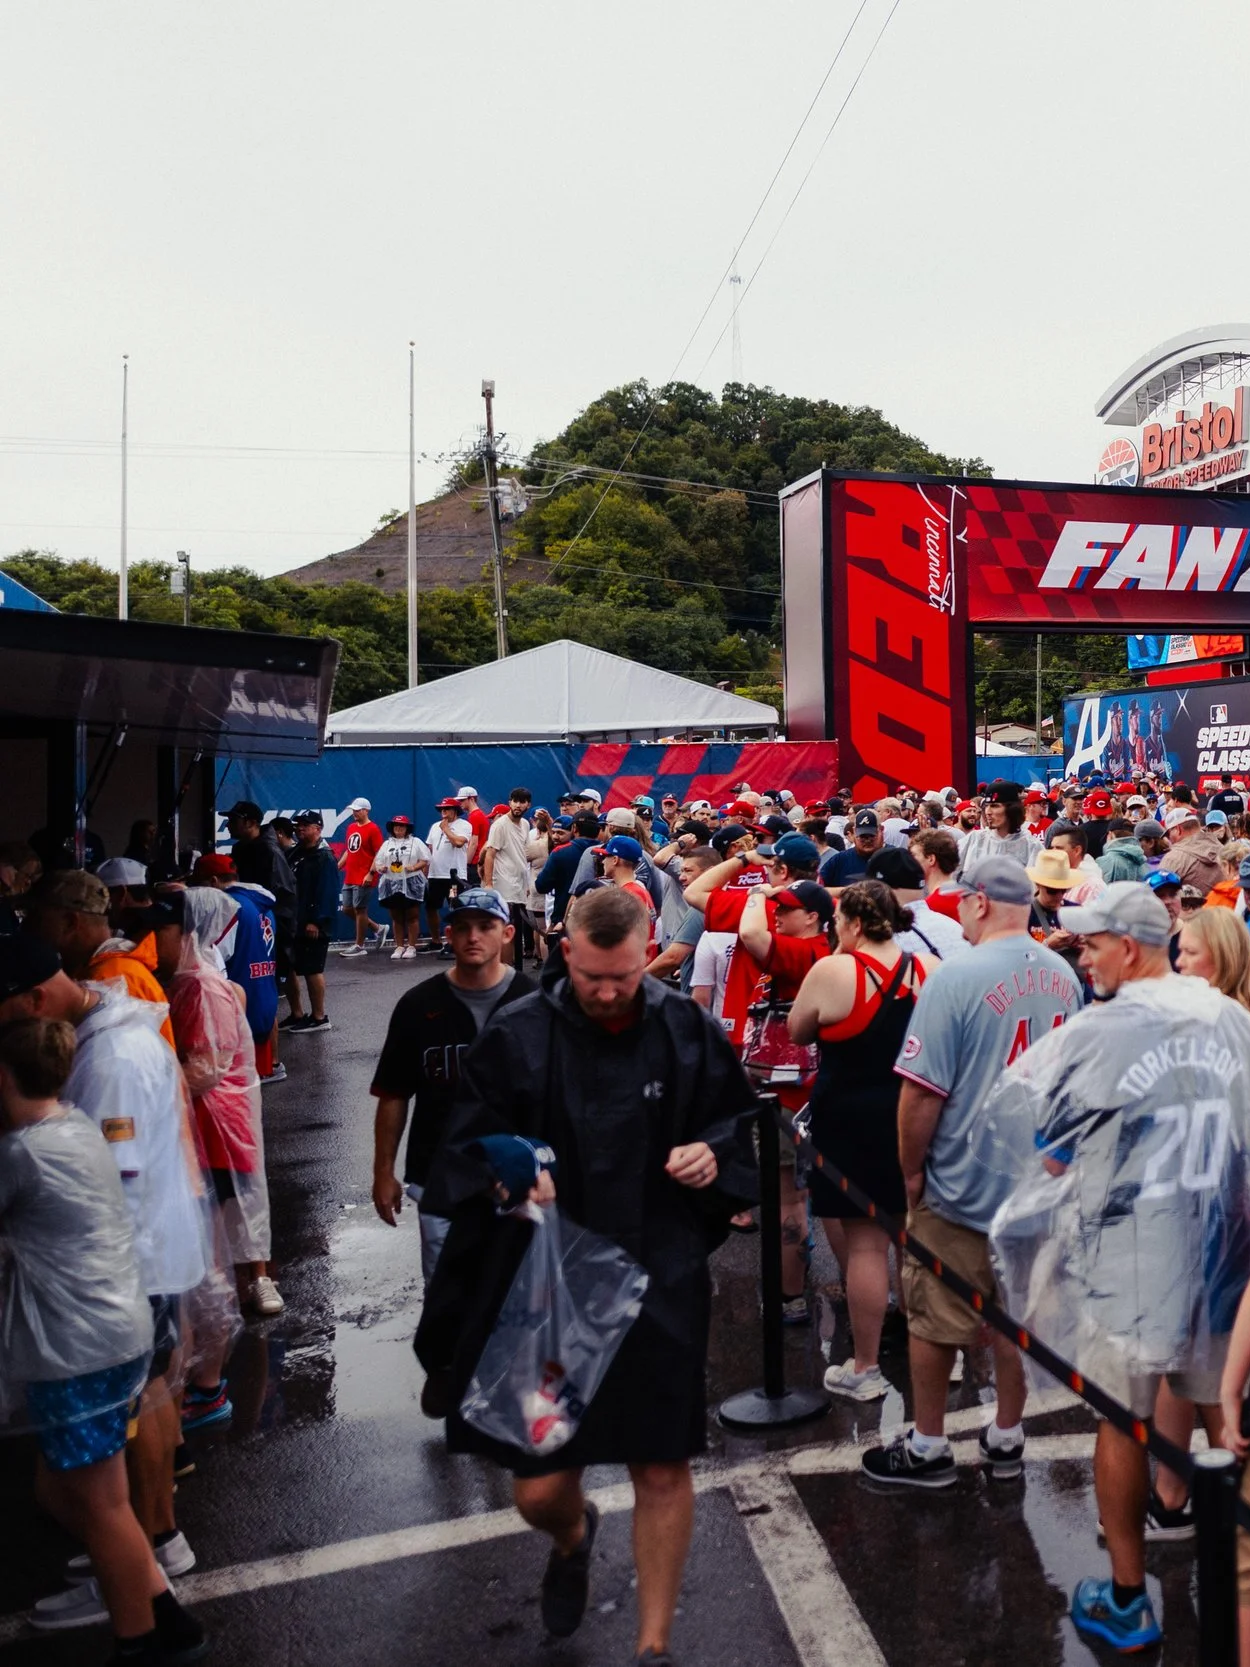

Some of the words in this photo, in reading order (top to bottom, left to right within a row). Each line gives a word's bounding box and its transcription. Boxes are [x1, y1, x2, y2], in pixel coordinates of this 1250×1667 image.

[1143, 386, 1245, 477] Bristol
[1184, 450, 1246, 486] SPEEDWAY
[845, 479, 952, 804] RED
[984, 982, 1012, 1017] DE
[1012, 971, 1037, 997] LA
[1039, 969, 1078, 1008] CRUZ
[1117, 1037, 1246, 1101] TORKELSON
[1137, 1098, 1233, 1200] 20
